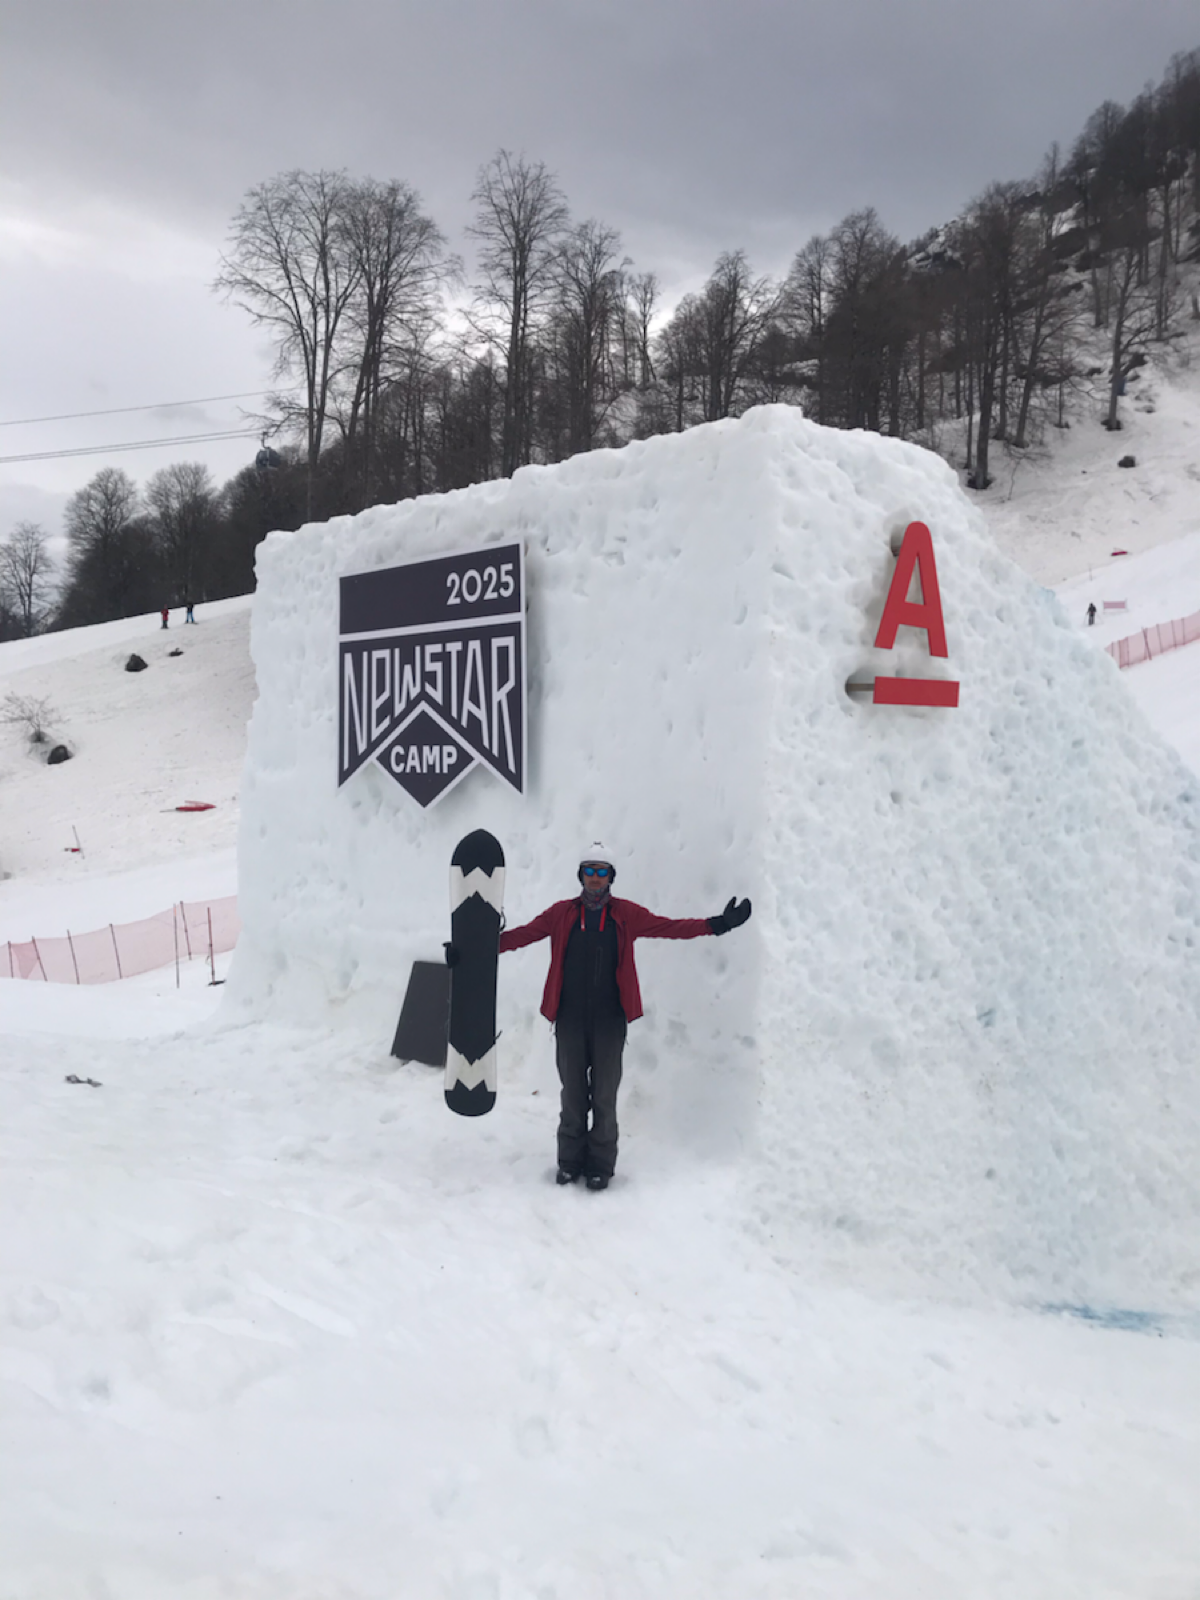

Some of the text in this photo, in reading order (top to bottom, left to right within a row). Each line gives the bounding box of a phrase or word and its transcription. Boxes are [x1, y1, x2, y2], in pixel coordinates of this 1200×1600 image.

[446, 563, 515, 605] 2025
[874, 521, 948, 658] A
[390, 745, 458, 774] CAMP
